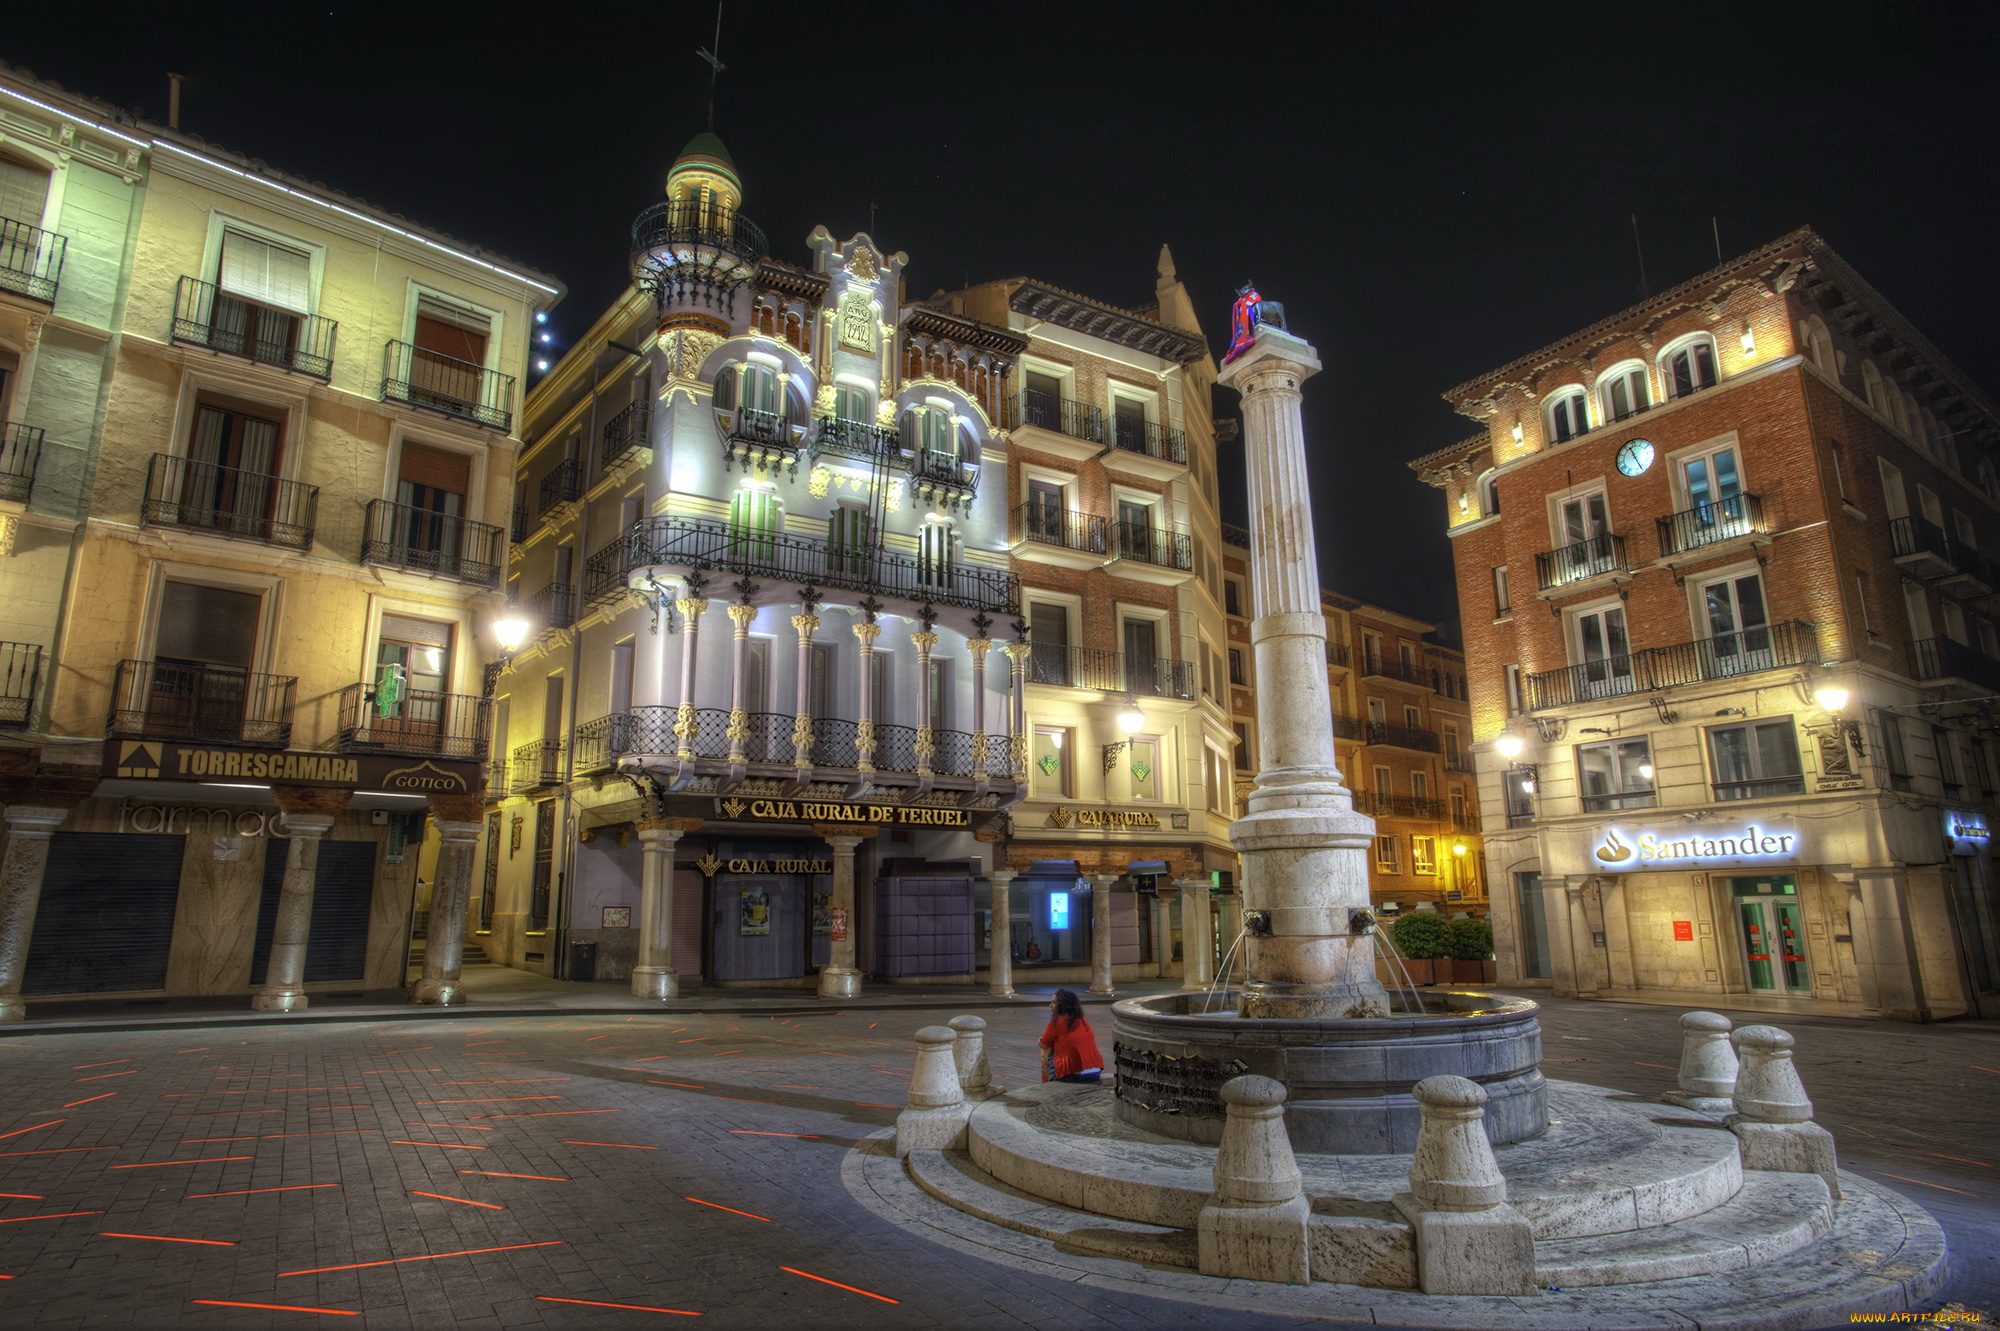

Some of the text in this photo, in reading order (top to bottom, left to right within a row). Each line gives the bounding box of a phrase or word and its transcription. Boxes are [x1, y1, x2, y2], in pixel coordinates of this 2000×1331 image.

[848, 323, 867, 343] 1912
[177, 749, 359, 782] TORRESCAMARA
[395, 776, 455, 790] GOTICO
[118, 795, 332, 839] farmac
[751, 800, 968, 826] CAJA RURAL DE TERUEL
[1637, 826, 1793, 860] Santander
[728, 859, 831, 874] CAJA RURAL
